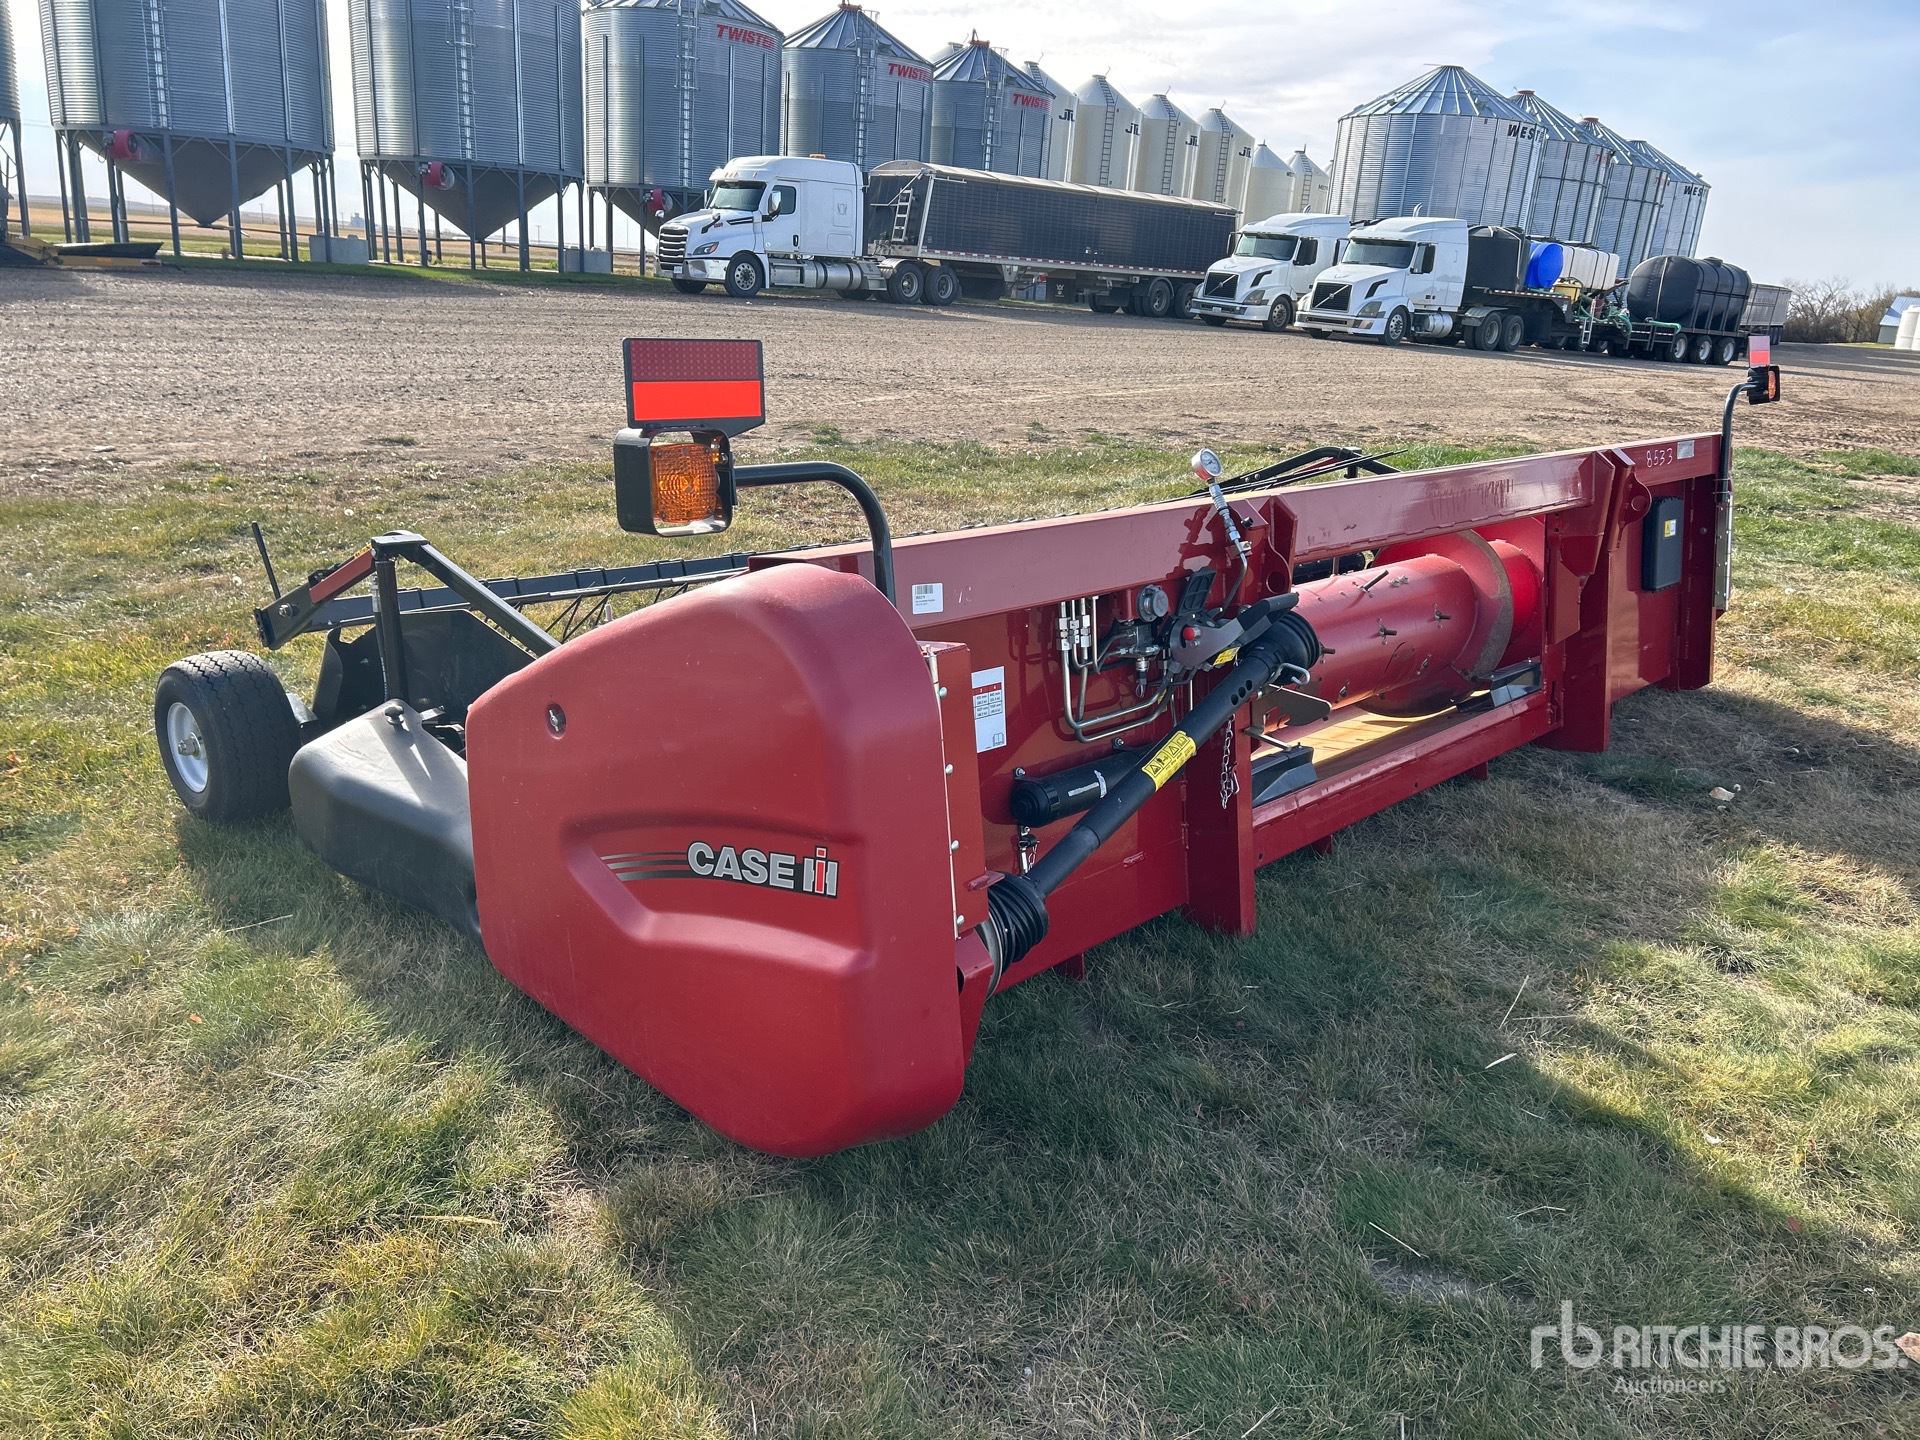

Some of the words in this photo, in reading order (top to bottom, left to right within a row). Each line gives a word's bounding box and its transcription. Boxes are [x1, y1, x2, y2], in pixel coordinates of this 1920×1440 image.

[1058, 108, 1076, 122] JTL
[1125, 122, 1141, 136] JTL
[1646, 447, 1674, 468] 8533
[687, 841, 796, 889] CASE
